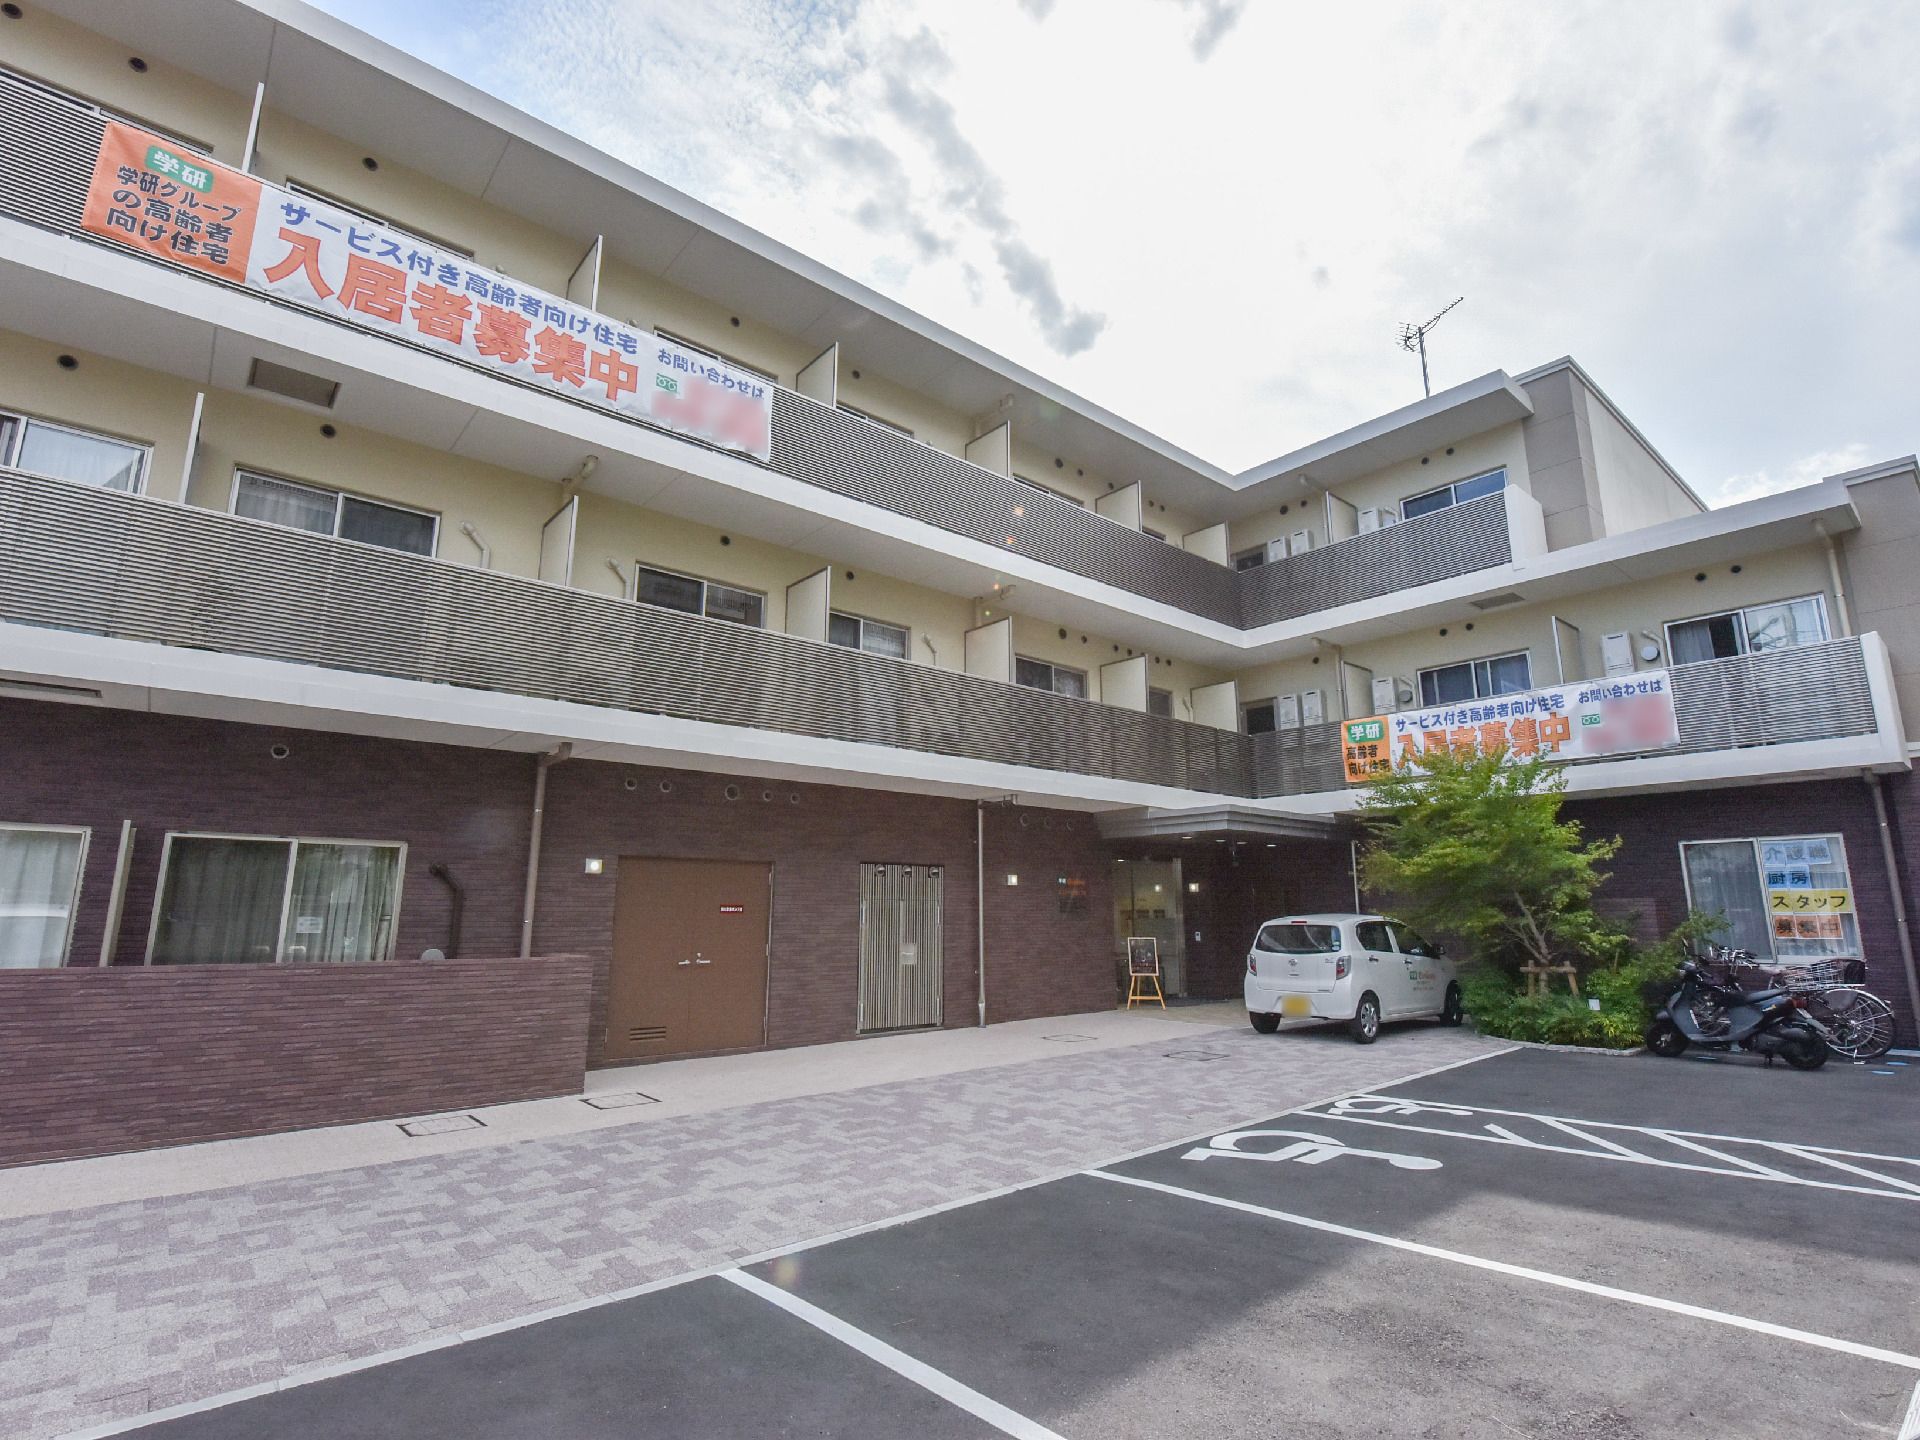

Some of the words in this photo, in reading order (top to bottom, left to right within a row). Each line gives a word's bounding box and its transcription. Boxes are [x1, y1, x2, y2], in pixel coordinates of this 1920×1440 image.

[153, 150, 208, 189] 学研
[117, 165, 241, 221] 学研グループ
[107, 207, 229, 264] 向け住宅
[112, 189, 233, 244] の高齢者
[280, 202, 639, 356] サービス付き高齢者向け住宅
[263, 226, 639, 402] 入居者募集中
[657, 348, 765, 400] お問い合わせは
[1396, 694, 1565, 732] サービス付き高齢者向け住宅
[1579, 680, 1663, 704] お問い合わせは
[1351, 723, 1380, 741] 学研
[1768, 871, 1808, 885] 厨房
[1773, 894, 1846, 909] スタッフ
